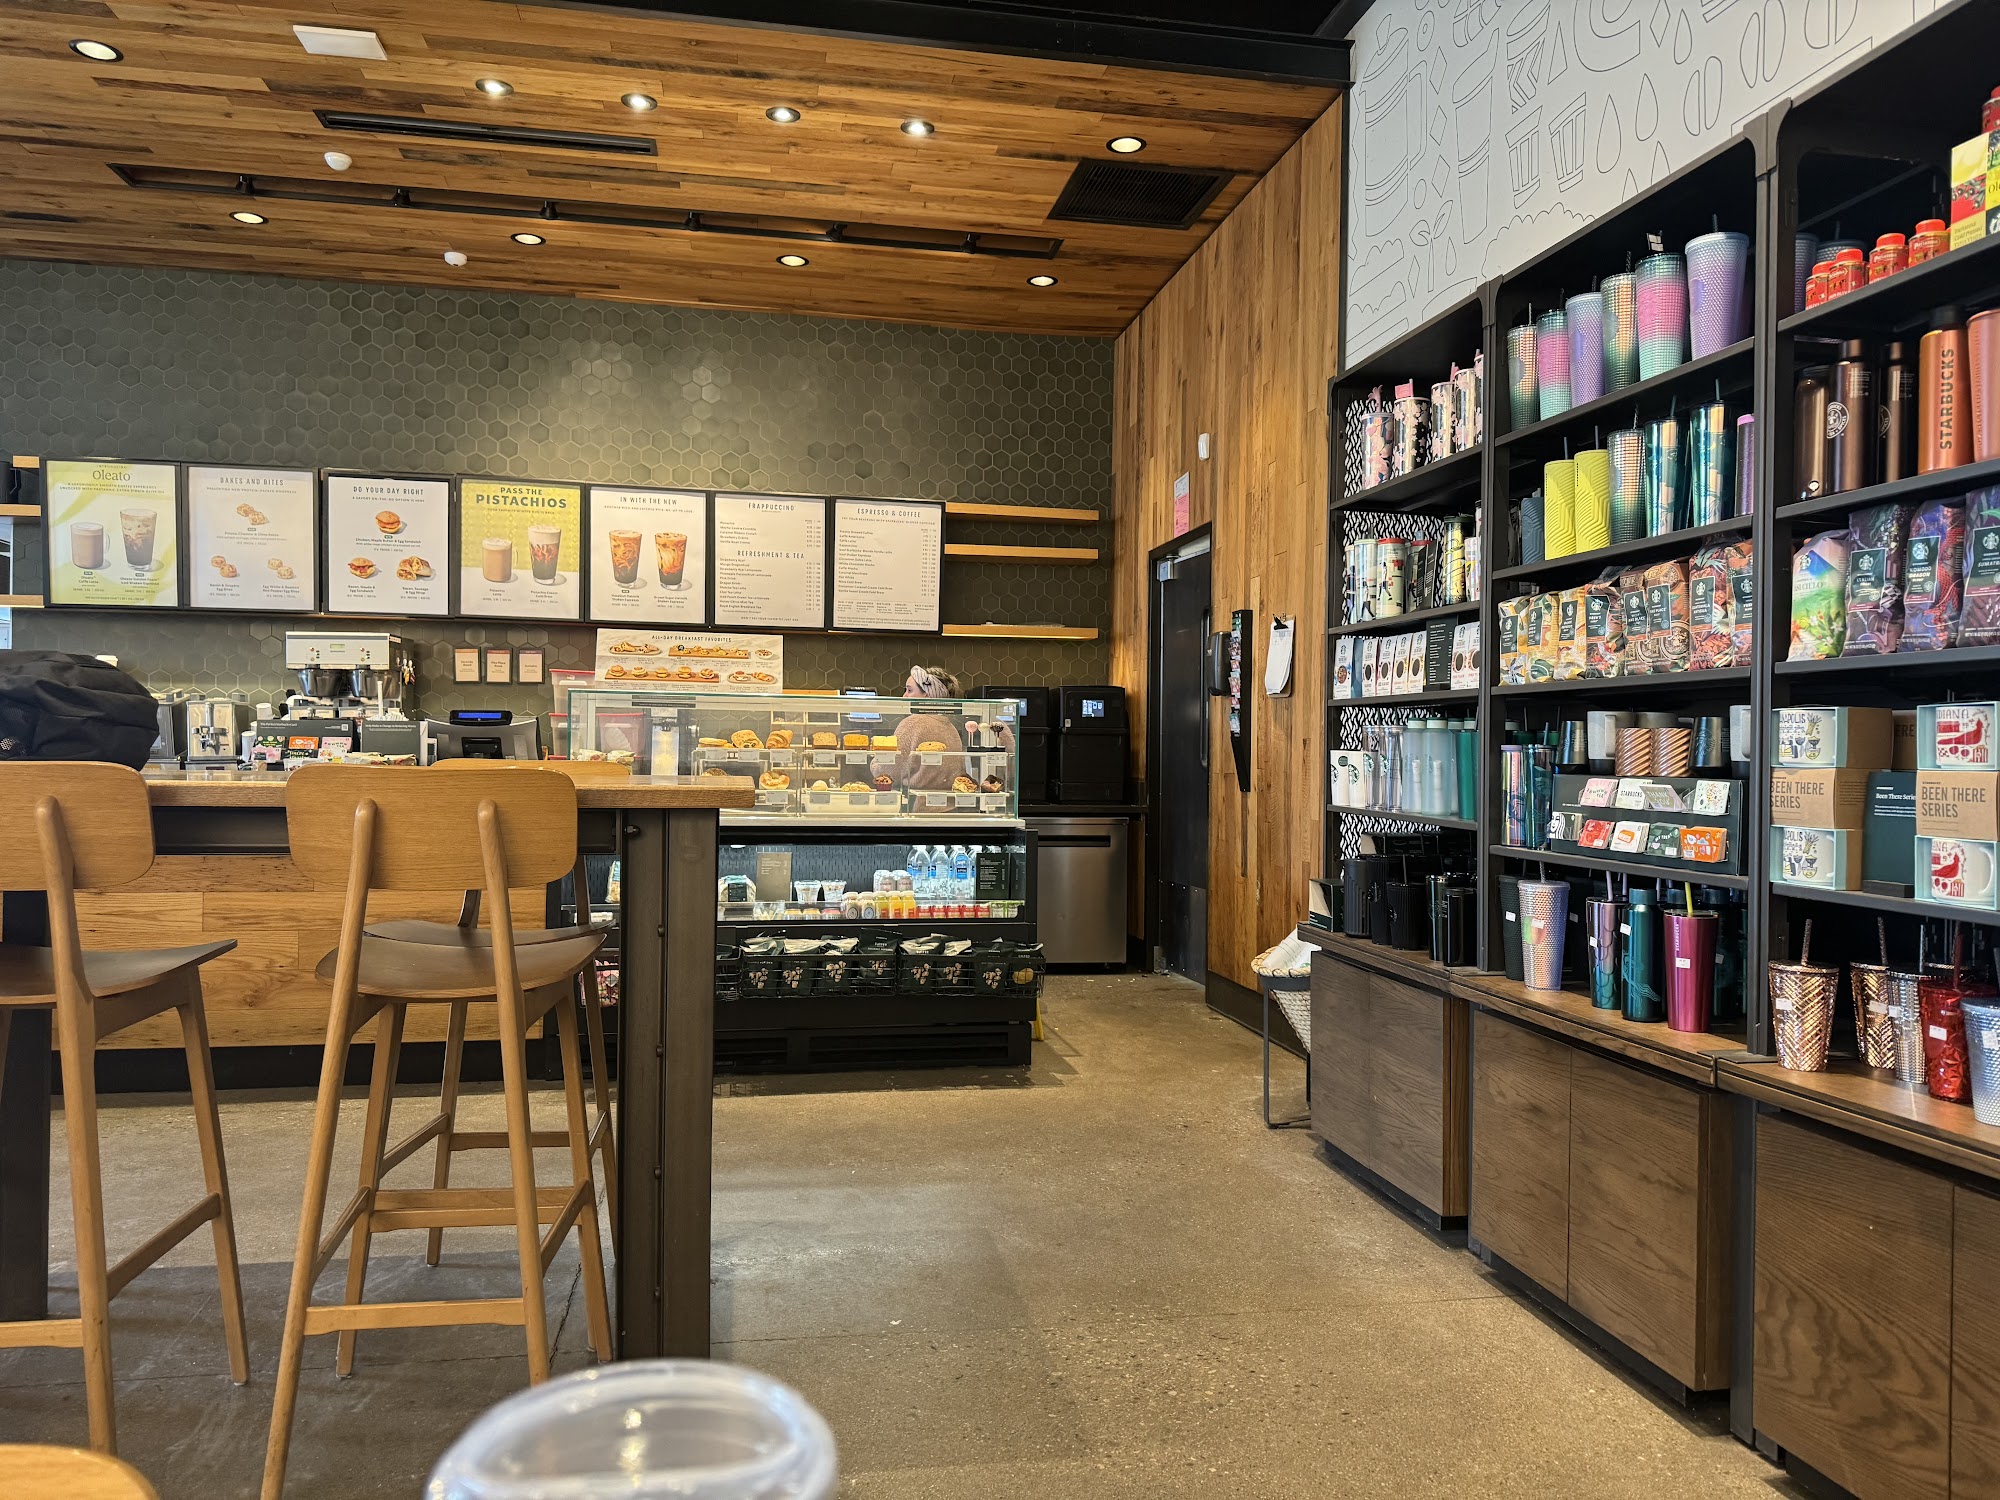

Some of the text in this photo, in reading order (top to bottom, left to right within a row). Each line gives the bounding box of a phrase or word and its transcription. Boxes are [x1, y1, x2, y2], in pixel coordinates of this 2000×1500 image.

[1939, 348, 1954, 450] STARBUCKS
[92, 470, 131, 481] Oleato
[476, 494, 567, 508] PISTACHIOS
[748, 502, 795, 511] FRAPPUCCINO
[857, 508, 889, 516] ESPRESSO
[898, 510, 920, 518] COFFEE
[737, 550, 783, 558] REFRESHMENT
[1896, 724, 1915, 737] ERE
[1620, 790, 1643, 798] STARBUCKS
[1795, 782, 1824, 795] THERE
[1922, 786, 1986, 802] BEEN THERE
[1922, 802, 1958, 818] SERIES
